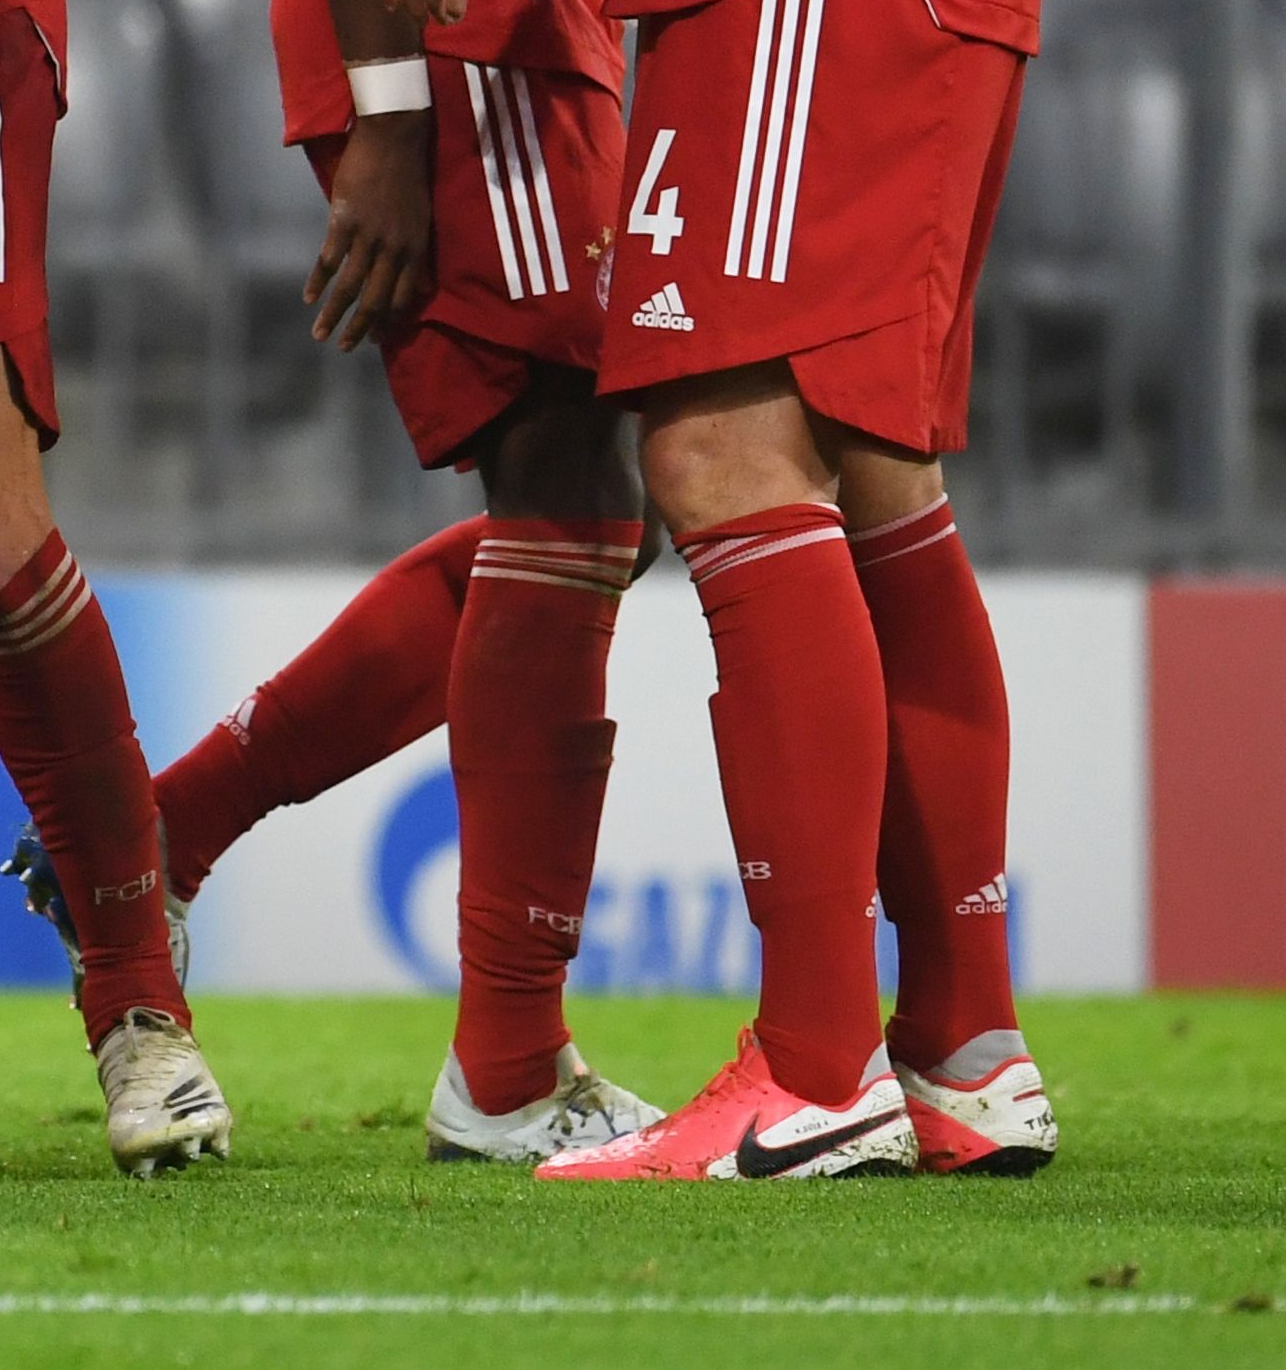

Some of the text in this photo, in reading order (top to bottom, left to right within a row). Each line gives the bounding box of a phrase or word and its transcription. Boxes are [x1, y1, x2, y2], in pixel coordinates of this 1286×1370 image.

[627, 129, 684, 255] 4
[632, 311, 694, 332] adidas
[95, 870, 156, 905] FCB
